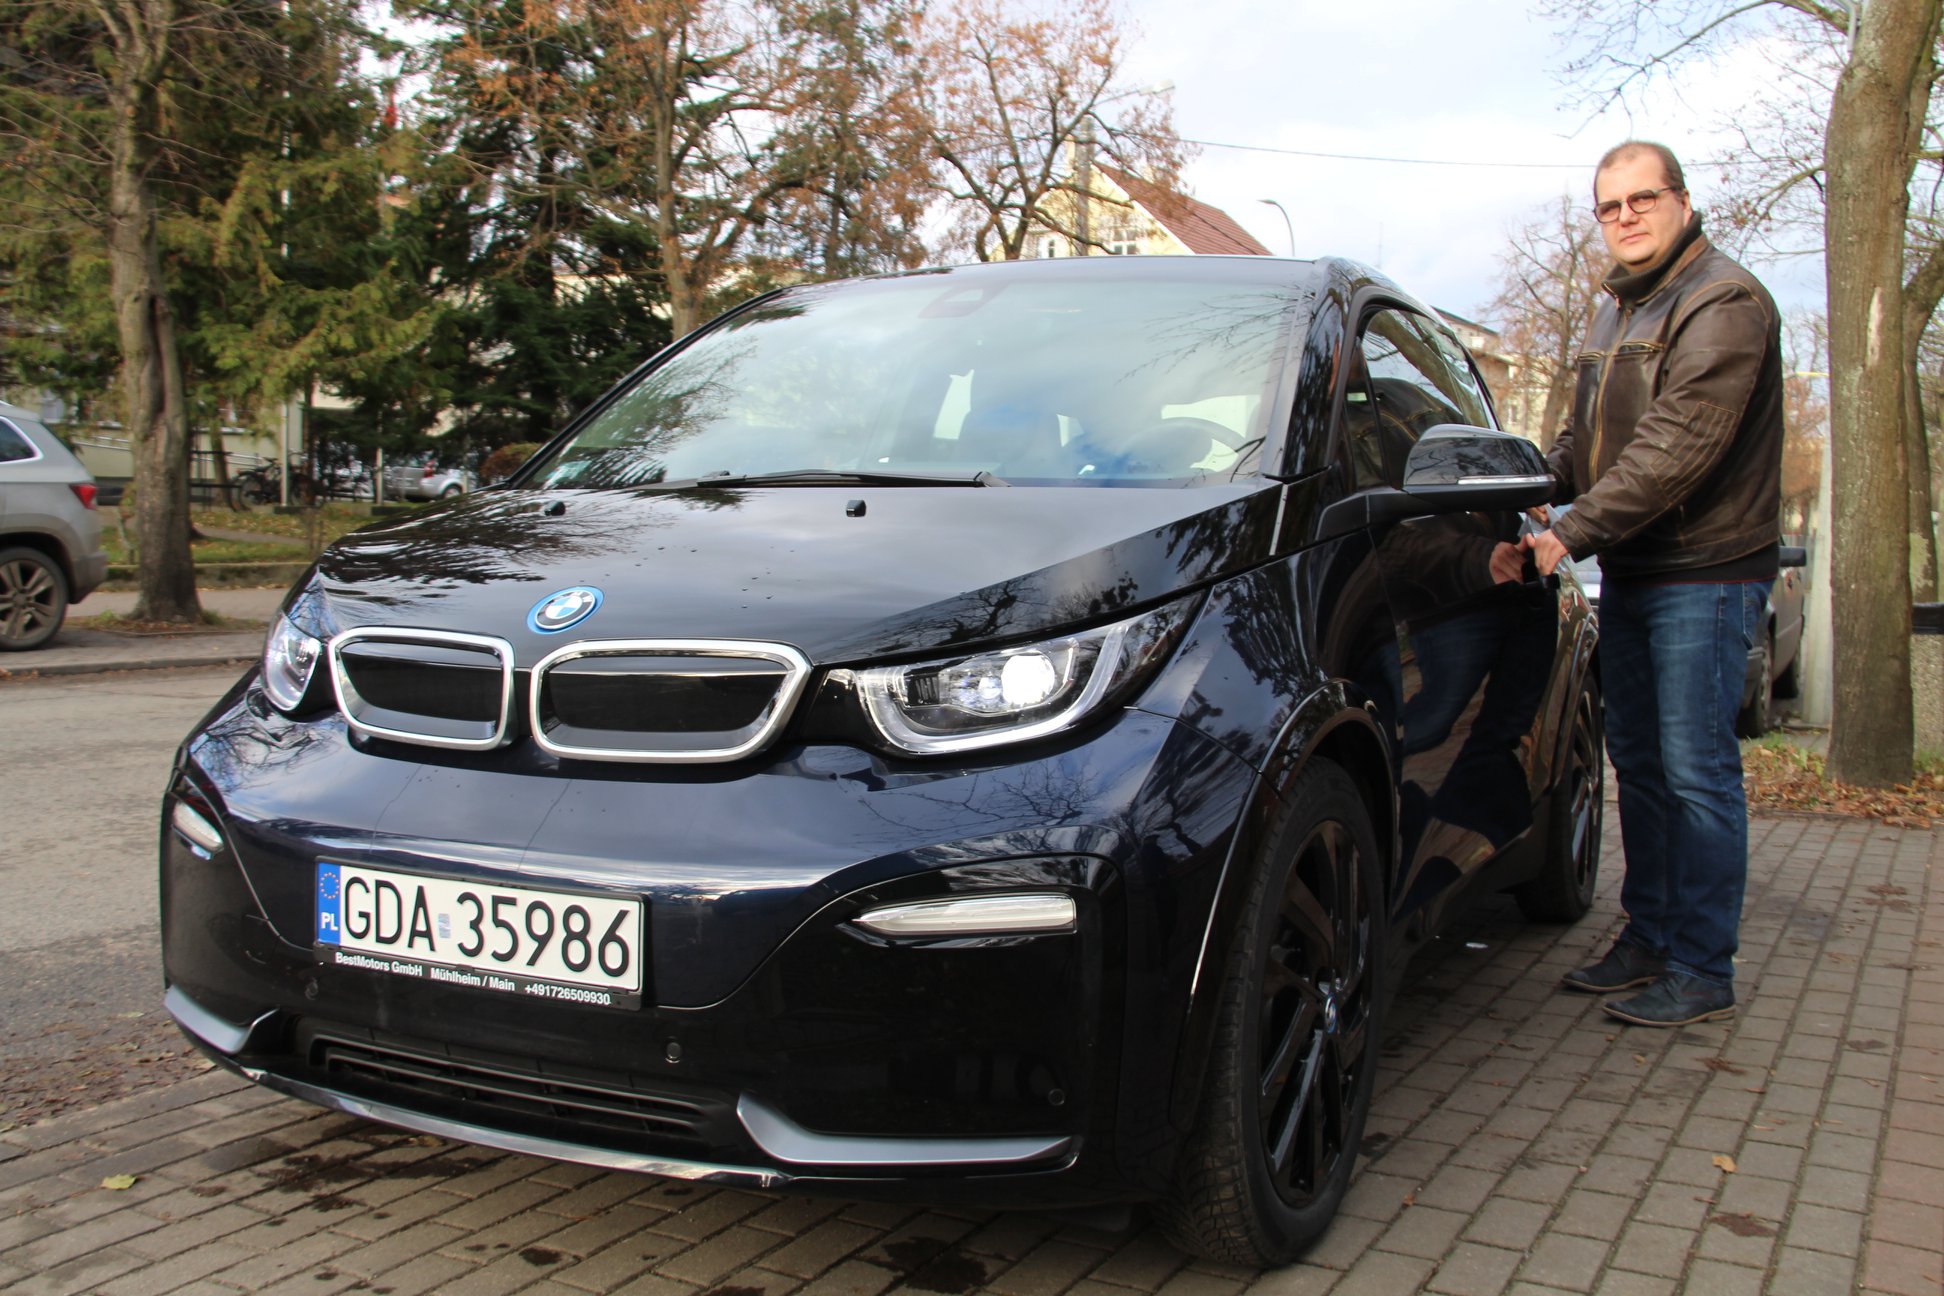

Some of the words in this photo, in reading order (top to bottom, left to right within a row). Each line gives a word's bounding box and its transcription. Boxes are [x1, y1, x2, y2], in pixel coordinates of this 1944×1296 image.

[321, 911, 338, 931] PL
[344, 876, 436, 952] GDA
[456, 891, 630, 978] 35986
[335, 952, 390, 972] BestMotors
[391, 961, 423, 977] GmbH
[430, 967, 481, 986] Mühlheim
[482, 976, 487, 987] /
[489, 976, 515, 991] Main
